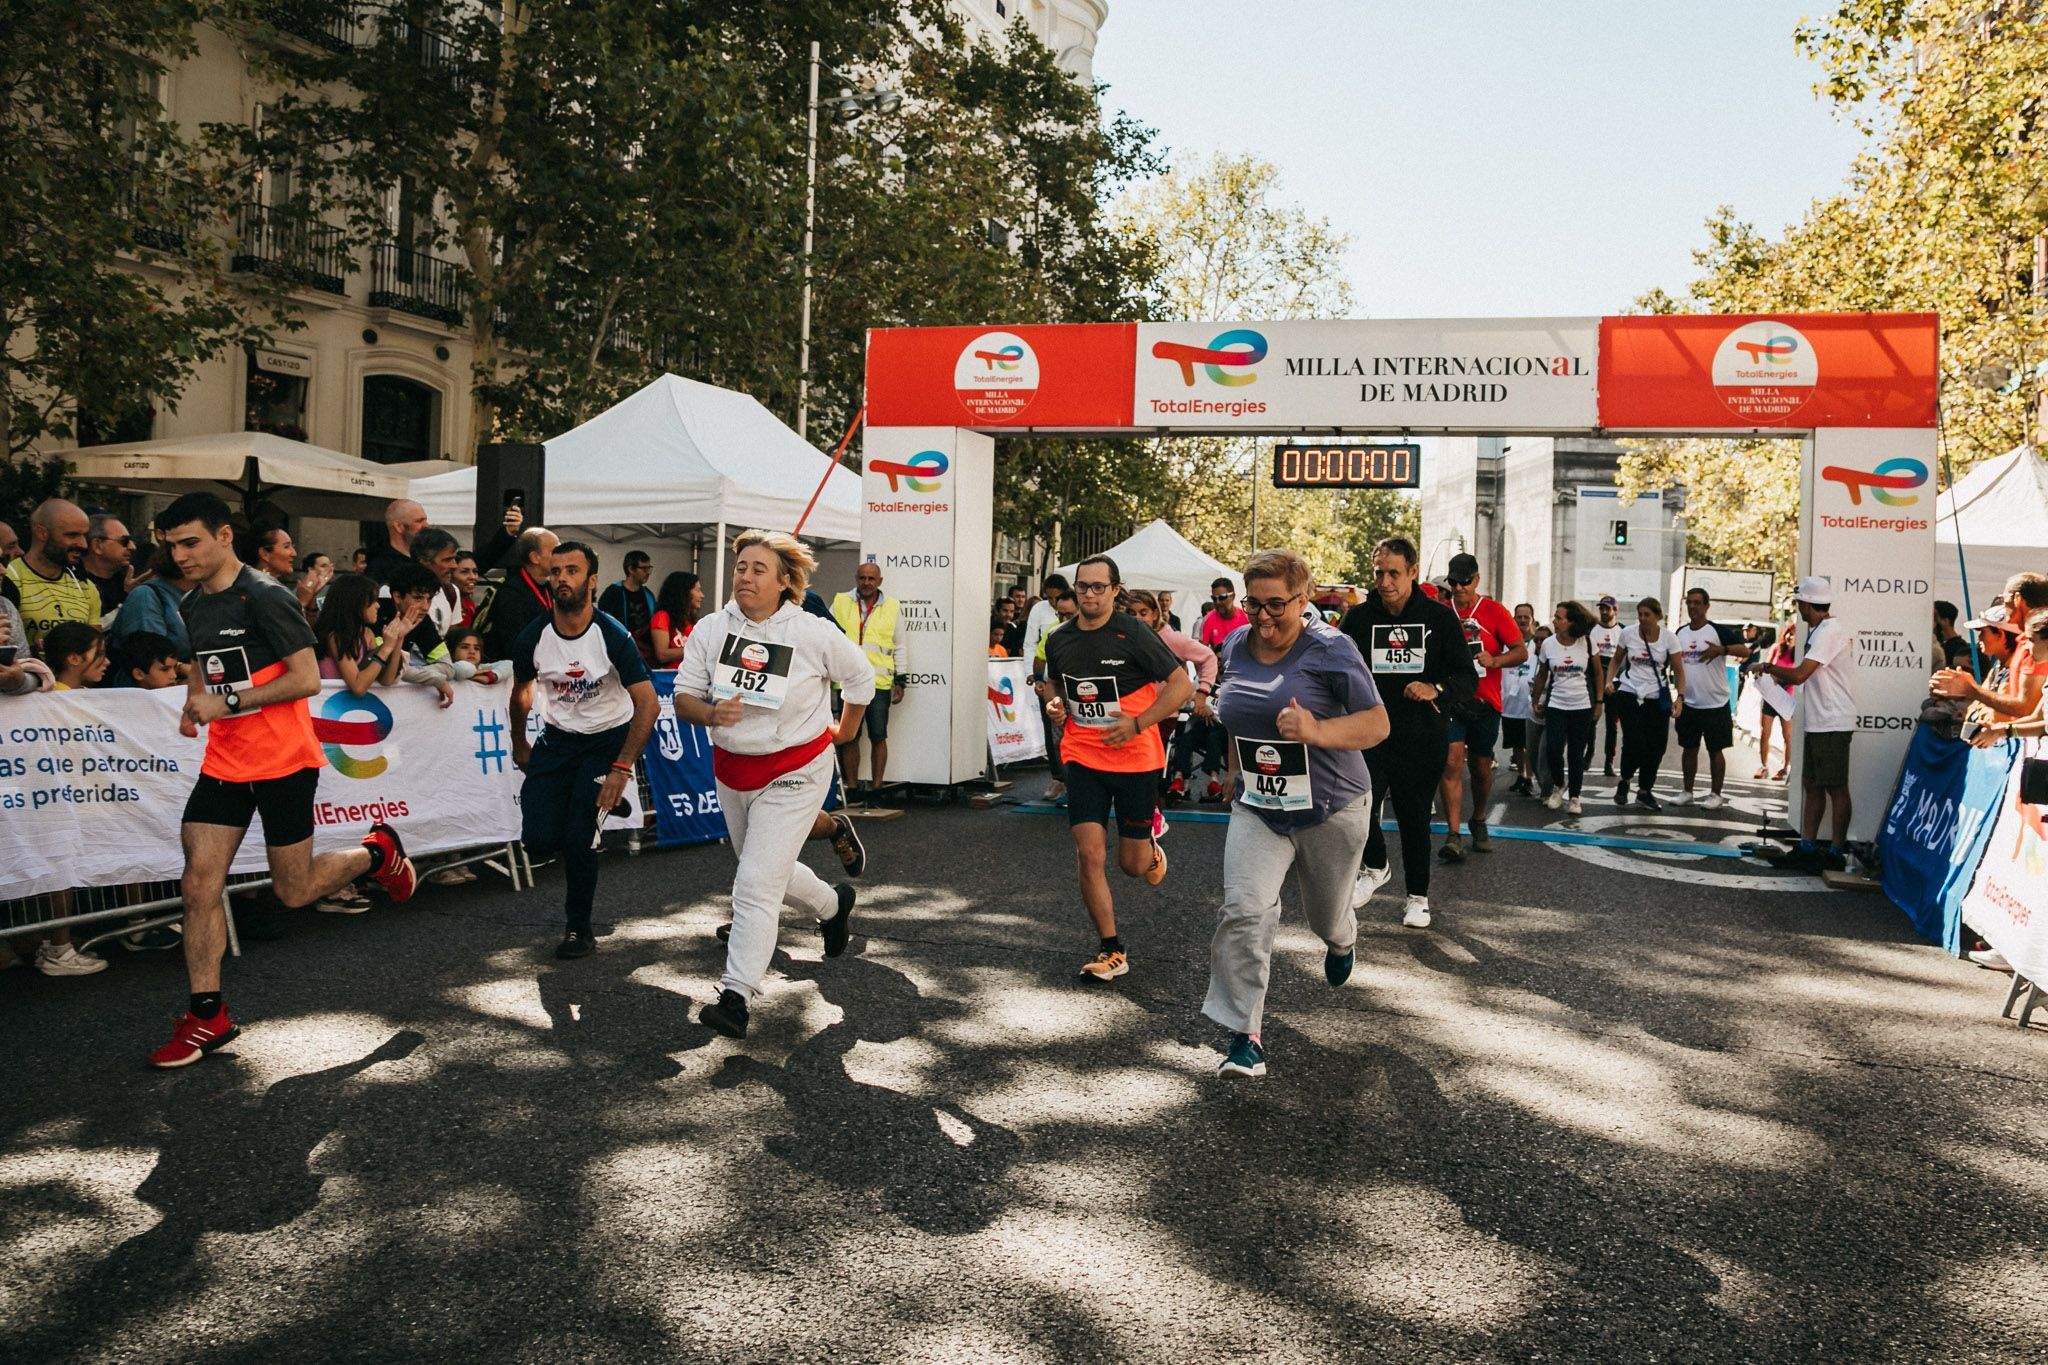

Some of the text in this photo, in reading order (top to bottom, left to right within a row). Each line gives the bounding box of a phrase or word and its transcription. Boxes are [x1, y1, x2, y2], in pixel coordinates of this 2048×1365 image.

[267, 357, 300, 370] CASTIZO
[1285, 357, 1366, 376] MILLA
[973, 376, 1024, 384] TotalEnergies
[1736, 370, 1798, 380] TotalEnergies
[1361, 384, 1508, 402] DE MADRID
[1750, 388, 1780, 396] MILLA
[975, 406, 1018, 414] DE MADRID
[1151, 399, 1267, 417] TotalEnergies
[1739, 405, 1791, 413] DE MADRID
[1282, 450, 1410, 482] 00:00:00
[350, 477, 375, 488] CASTIZO
[868, 501, 949, 515] TotalEnergies
[1820, 516, 1928, 532] TotalEnergies
[886, 555, 950, 567] MADRID
[1843, 578, 1929, 594] MADRID
[905, 620, 947, 632] RBANA
[1859, 639, 1916, 652] MILLA
[1386, 649, 1411, 663] 455
[1857, 654, 1923, 669] URBANA
[730, 669, 768, 693] 452
[1078, 702, 1106, 718] 430
[11, 725, 116, 746] compañía
[82, 754, 179, 776] patrocina
[1256, 775, 1288, 797] 442
[313, 797, 410, 826] lEnergies
[668, 792, 694, 817] ES
